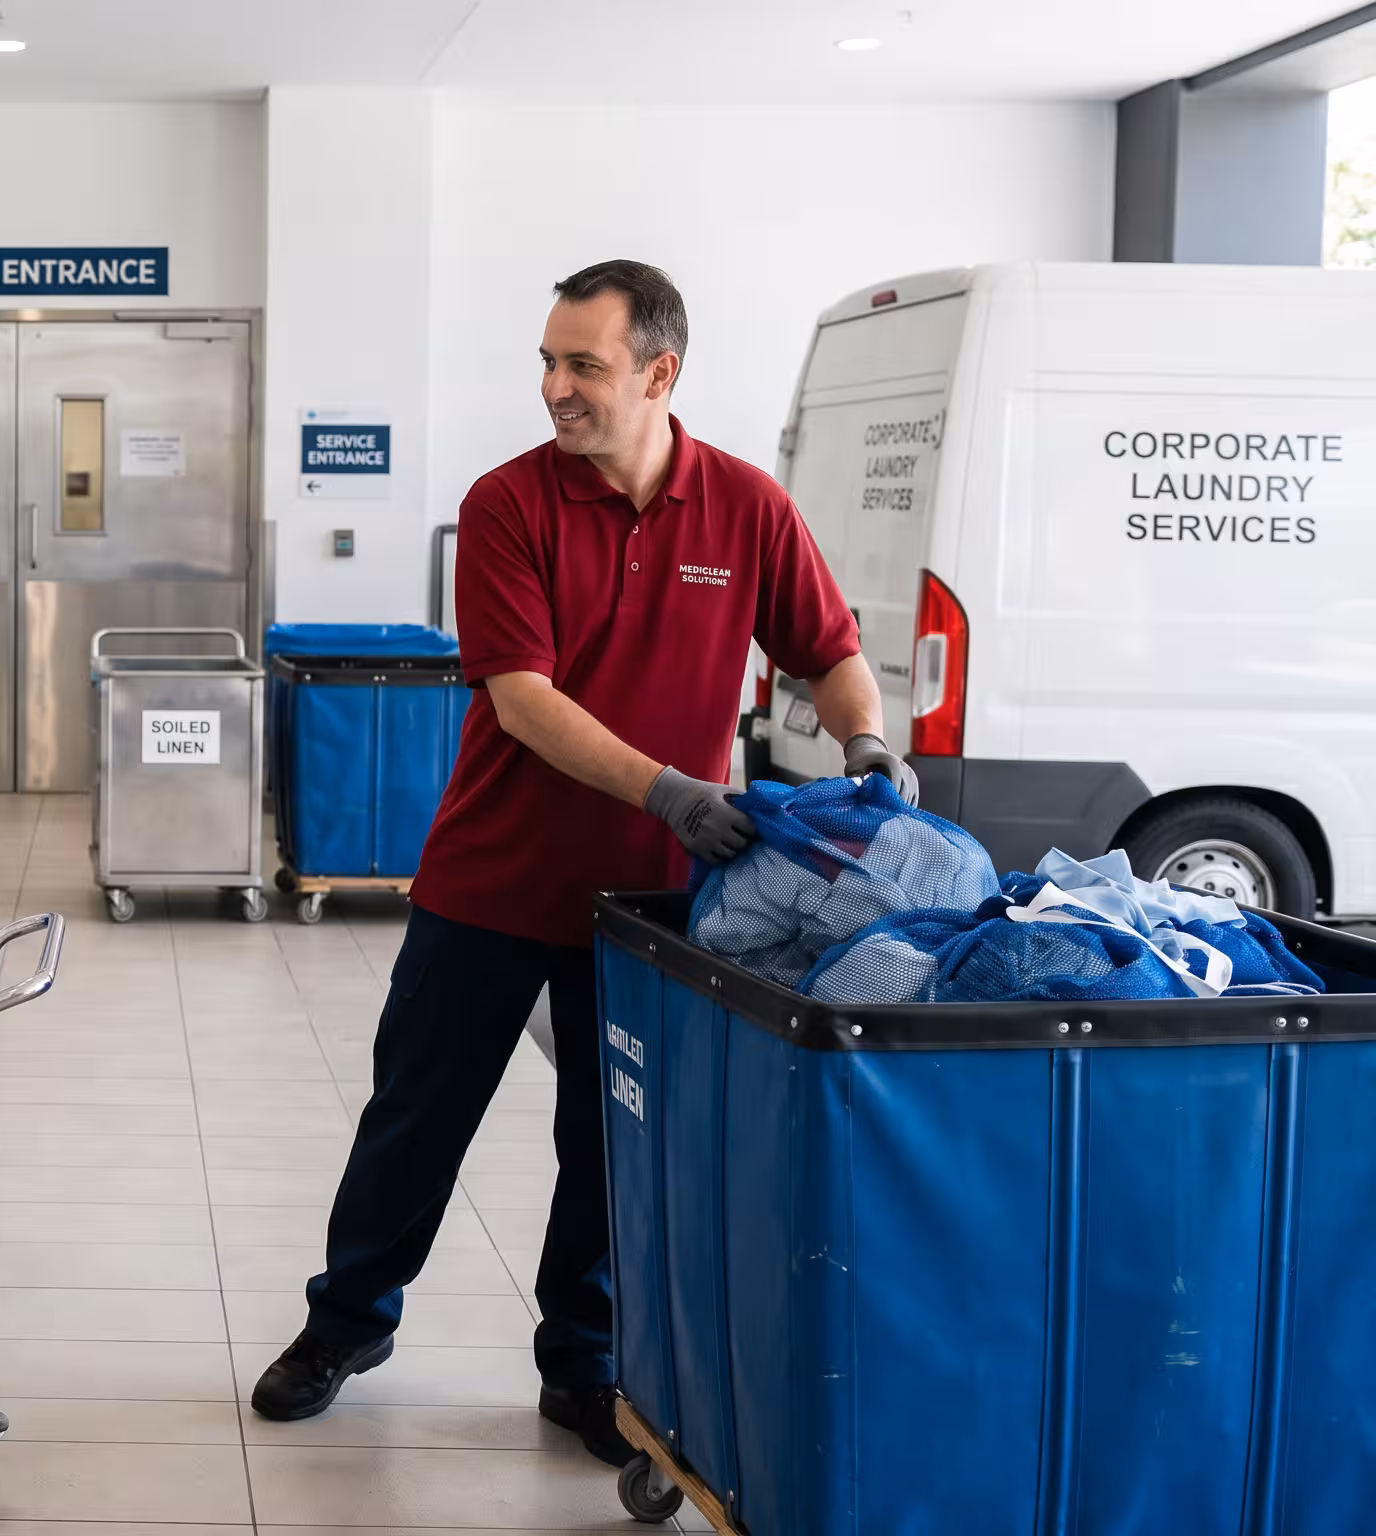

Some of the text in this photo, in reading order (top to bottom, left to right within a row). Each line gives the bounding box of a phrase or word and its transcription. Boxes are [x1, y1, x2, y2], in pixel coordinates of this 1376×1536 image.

[2, 259, 156, 285] ENTRANCE
[316, 434, 376, 449] SERVICE
[1104, 431, 1343, 462] CORPORATE
[307, 451, 384, 465] ENTRANCE
[1131, 473, 1314, 502] LAUNDRY
[1126, 514, 1316, 543] SERVICES
[679, 564, 731, 577] MEDICLEAN
[682, 574, 728, 587] SOLUTIONS
[151, 720, 210, 733] SOILED
[157, 740, 204, 753] LINEN
